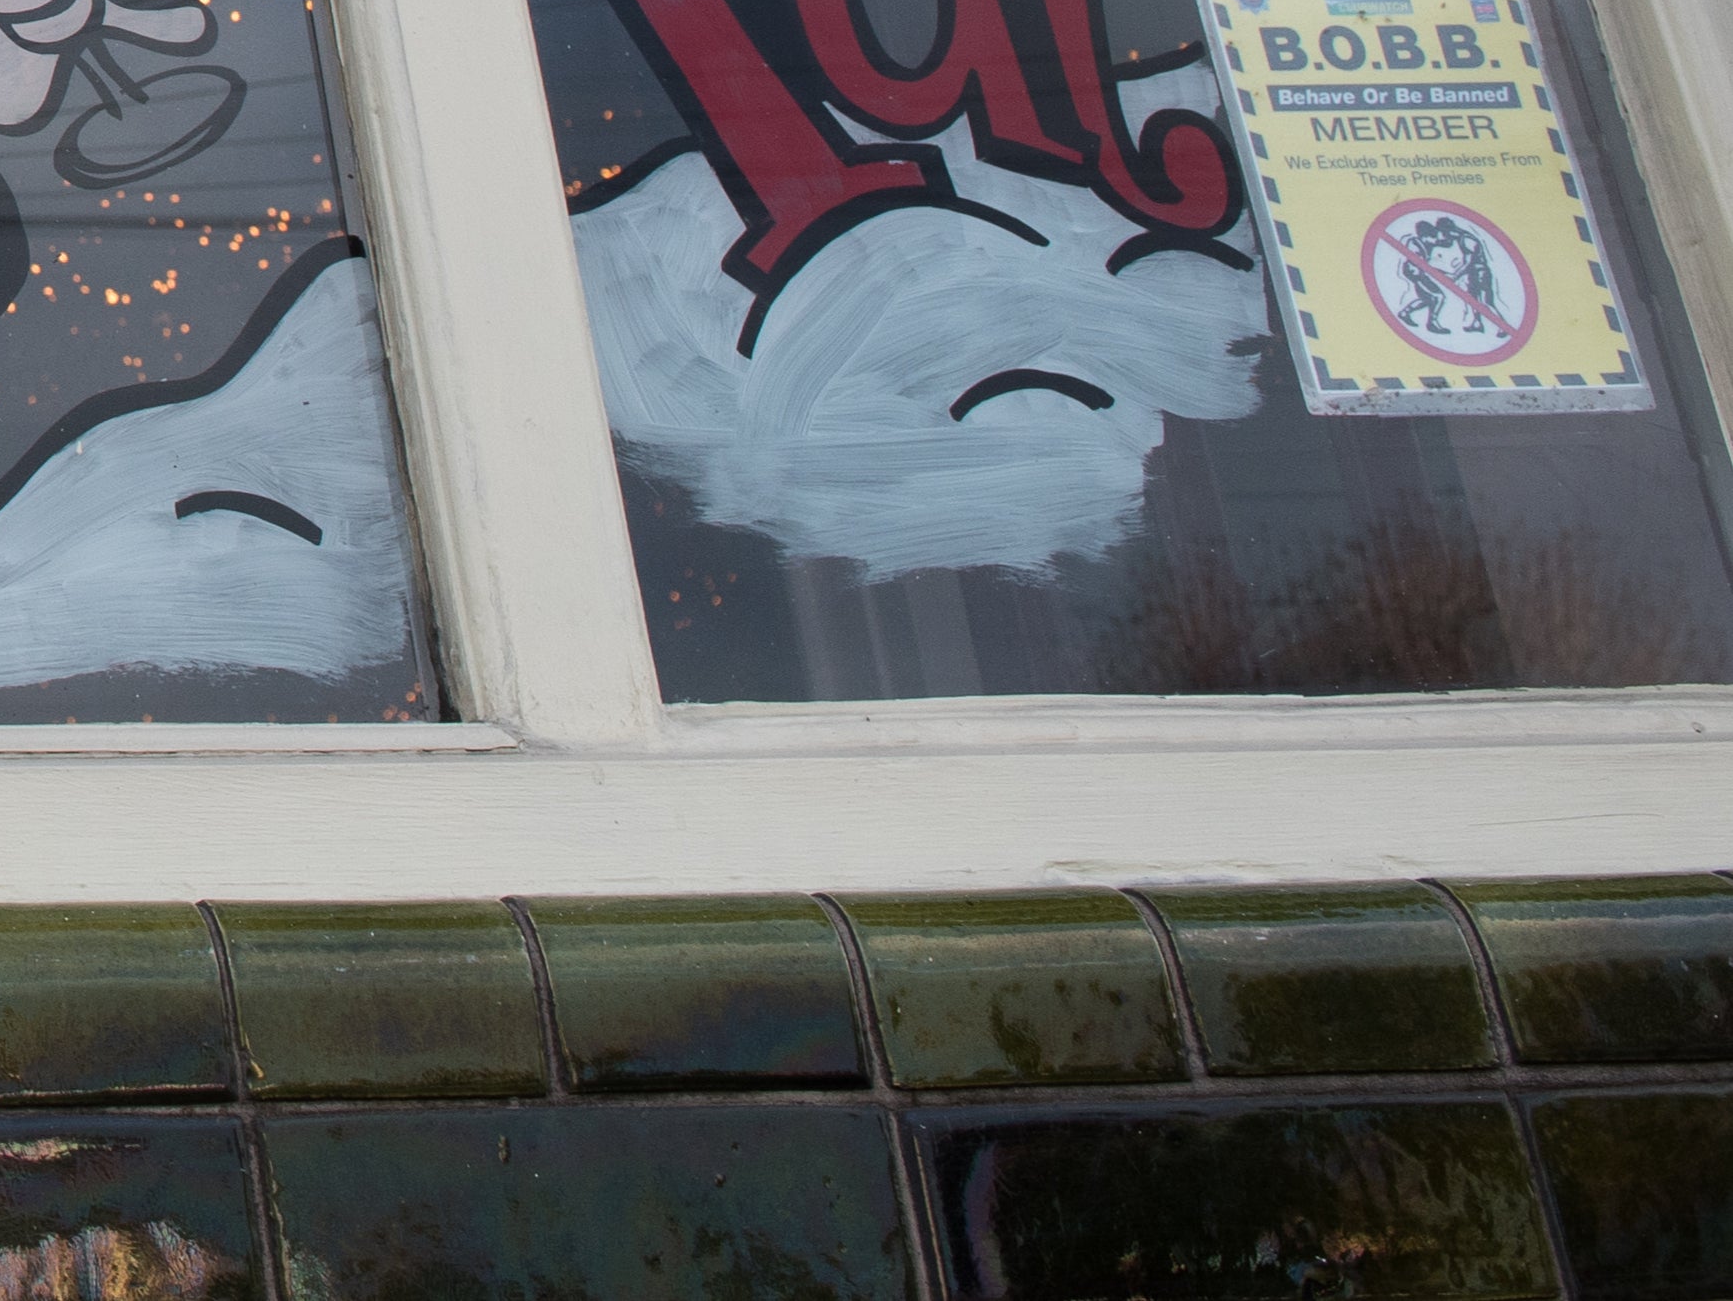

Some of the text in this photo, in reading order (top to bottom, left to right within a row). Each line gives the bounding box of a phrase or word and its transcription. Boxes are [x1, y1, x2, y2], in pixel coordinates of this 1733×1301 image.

[1259, 24, 1501, 72] B.O.B.B.
[1278, 85, 1509, 106] Behave Or Be Banned
[1310, 114, 1499, 142] MEMBER
[1284, 151, 1542, 170] We Exclude Troublemakers From
[1357, 170, 1485, 186] These Premises
